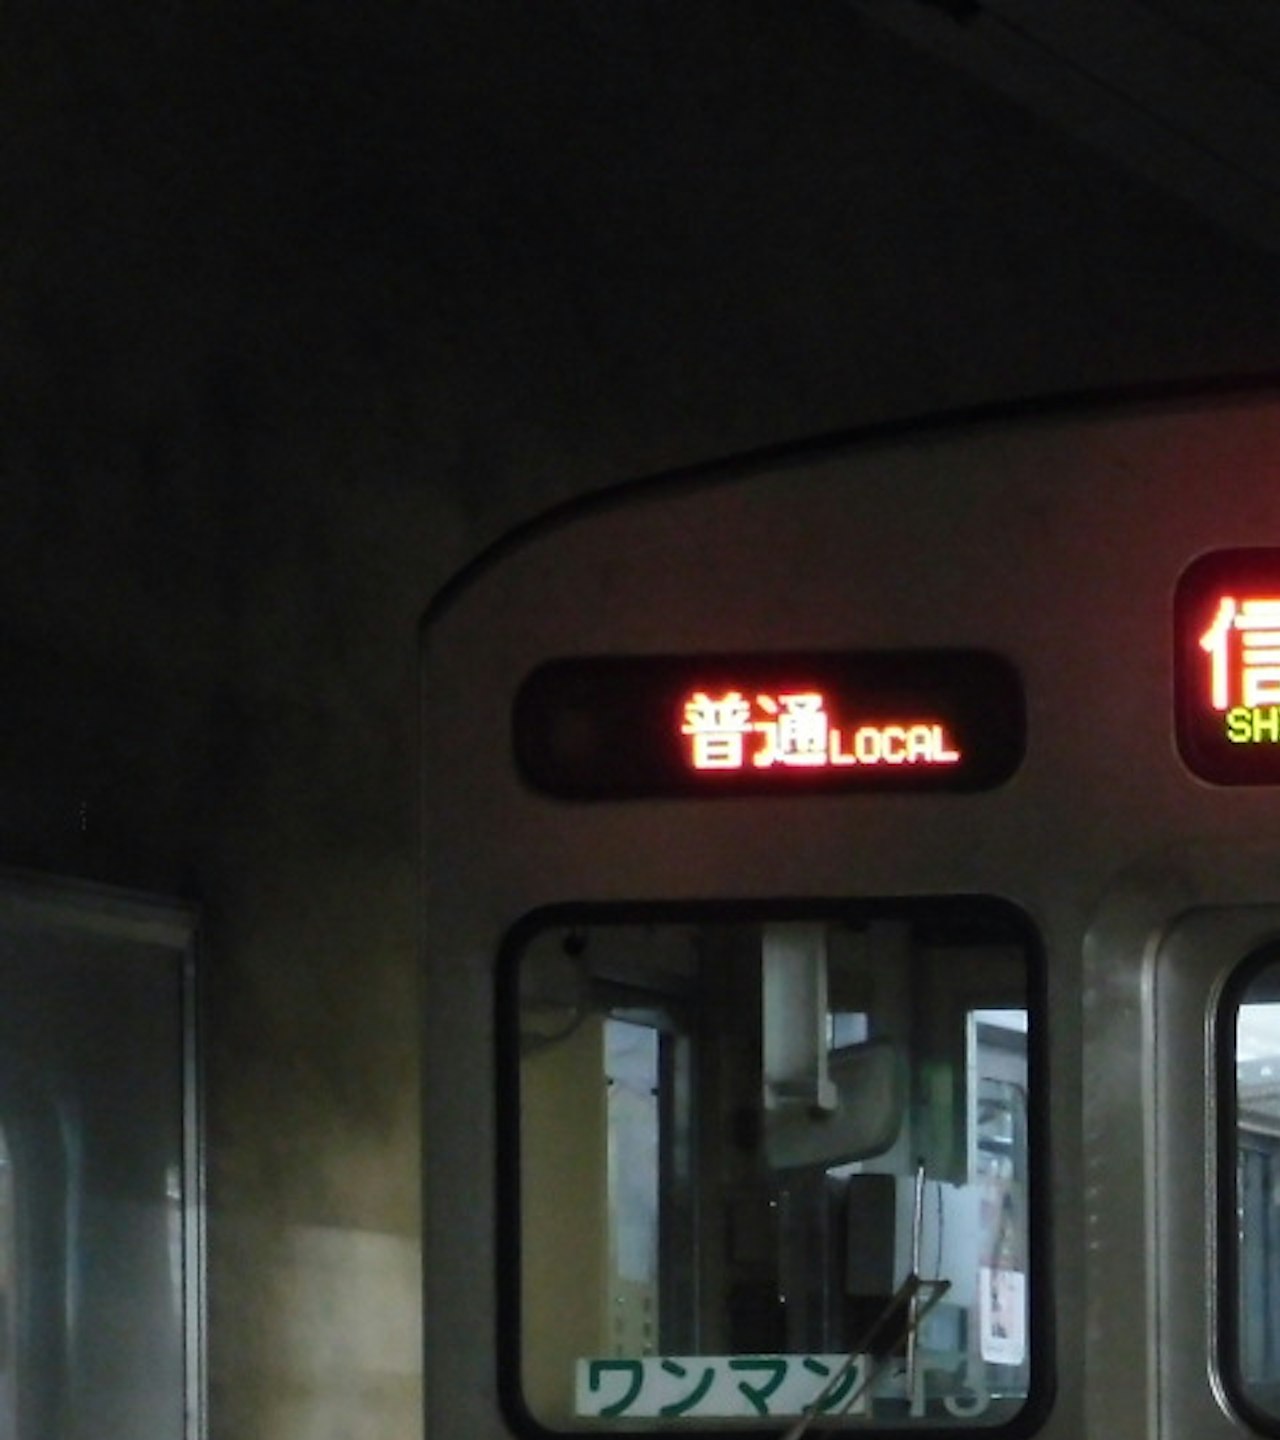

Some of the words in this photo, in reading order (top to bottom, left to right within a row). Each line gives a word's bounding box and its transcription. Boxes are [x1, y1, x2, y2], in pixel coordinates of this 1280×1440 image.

[681, 692, 829, 770] 普通
[829, 724, 960, 765] LOCAL
[587, 1358, 856, 1418] ワンマン
